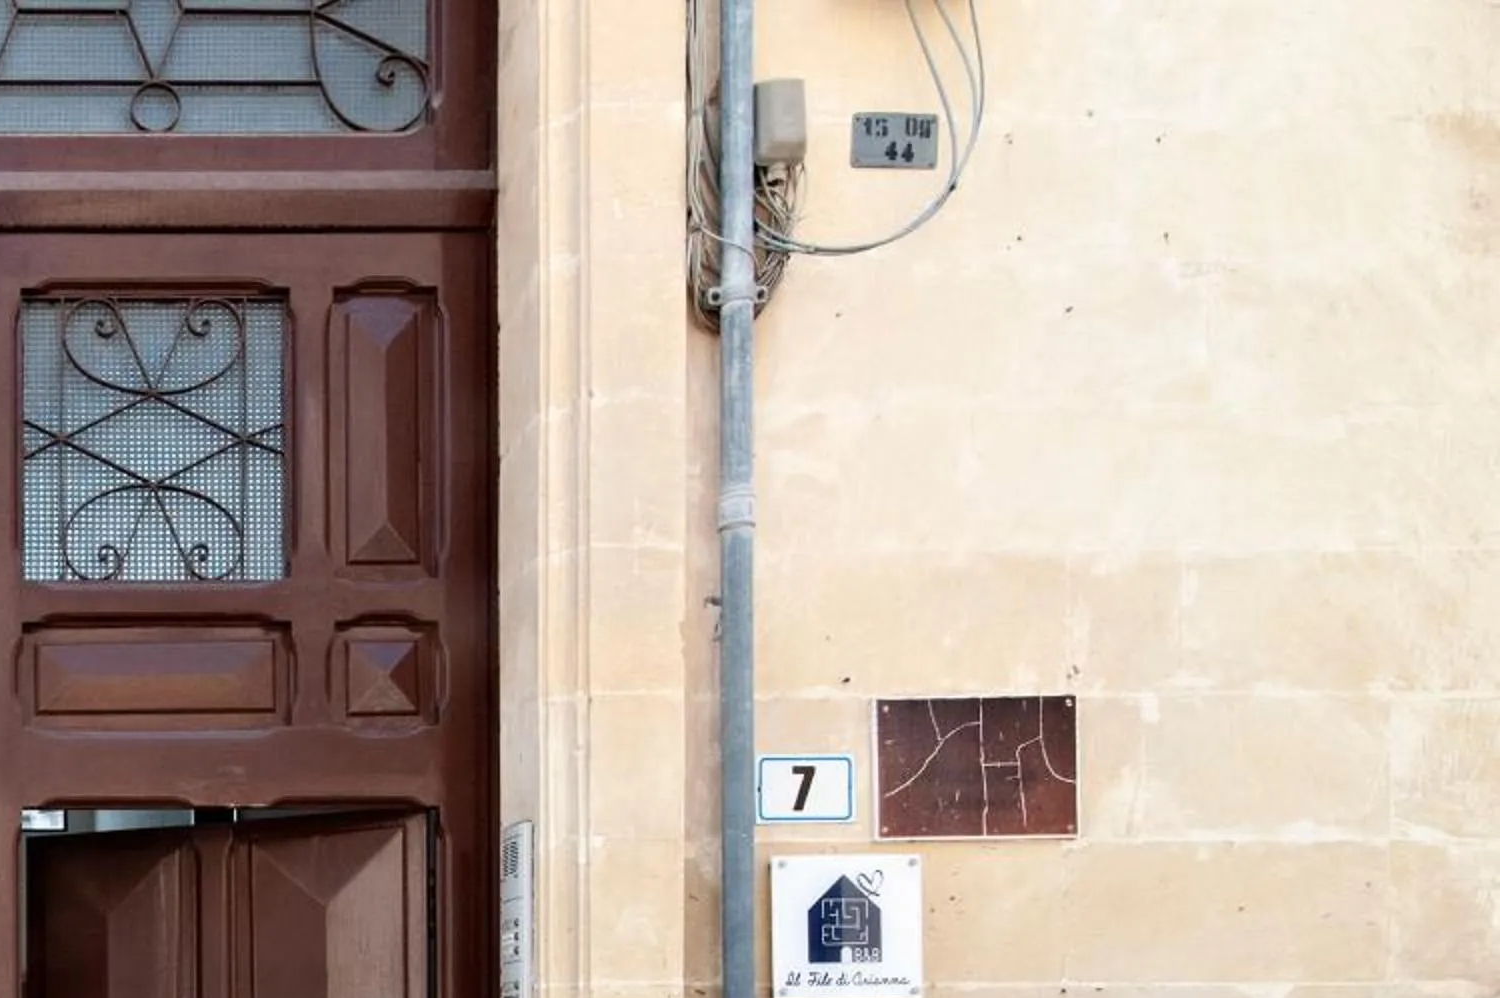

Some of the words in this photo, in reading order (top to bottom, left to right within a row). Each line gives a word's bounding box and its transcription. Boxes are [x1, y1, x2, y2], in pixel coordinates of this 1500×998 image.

[863, 117, 889, 137] 15
[884, 141, 915, 162] 44
[791, 765, 816, 811] 7
[854, 947, 881, 962] B&B
[836, 971, 850, 986] di
